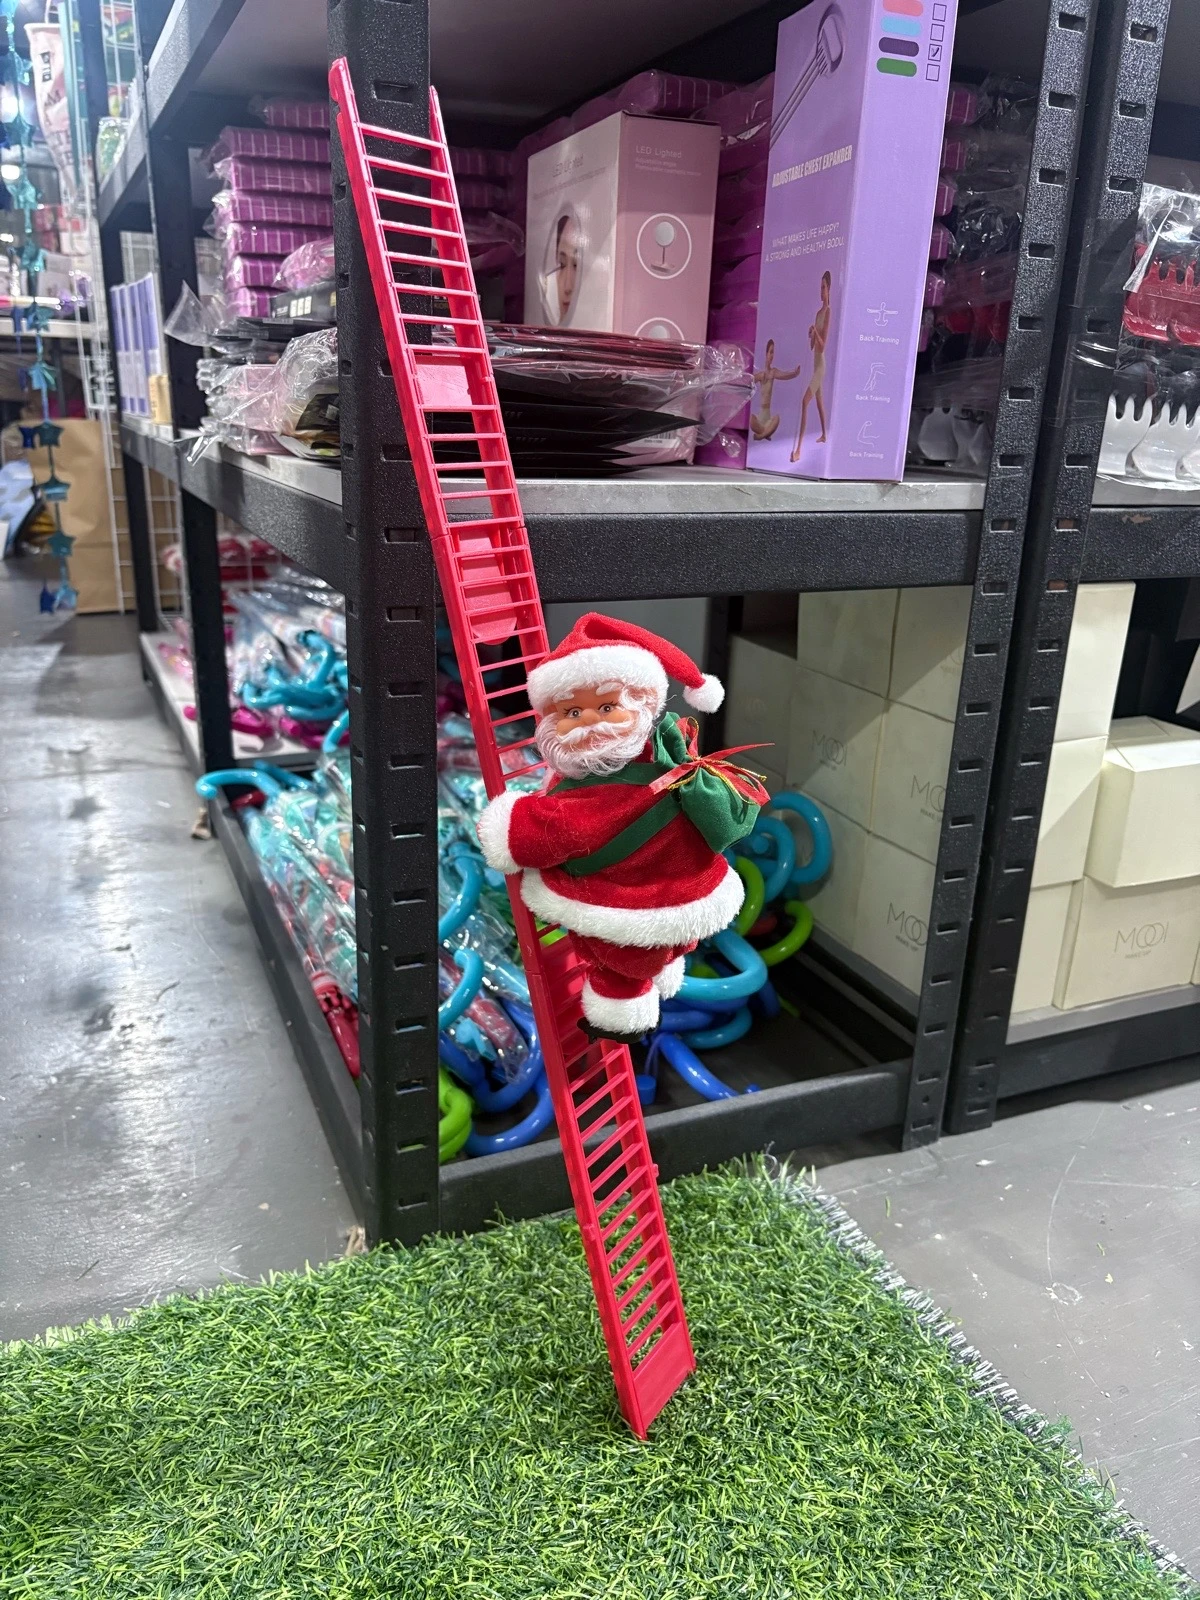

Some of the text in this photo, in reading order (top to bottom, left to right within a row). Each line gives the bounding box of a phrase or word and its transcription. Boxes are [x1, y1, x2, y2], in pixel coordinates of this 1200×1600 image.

[635, 145, 682, 159] LED Lighted
[771, 144, 853, 188] ADJUSTABLE CHEST EXPANDER
[772, 222, 840, 248] WHAT MAKES LIFE HAPPY?
[770, 249, 790, 262] STRONG
[789, 245, 801, 258] AND
[802, 238, 827, 254] HEALTHY
[859, 334, 900, 345] Back Training
[869, 395, 891, 403] Training
[863, 451, 885, 460] Training
[886, 902, 928, 946] MOO
[1114, 921, 1169, 953] MOOI
